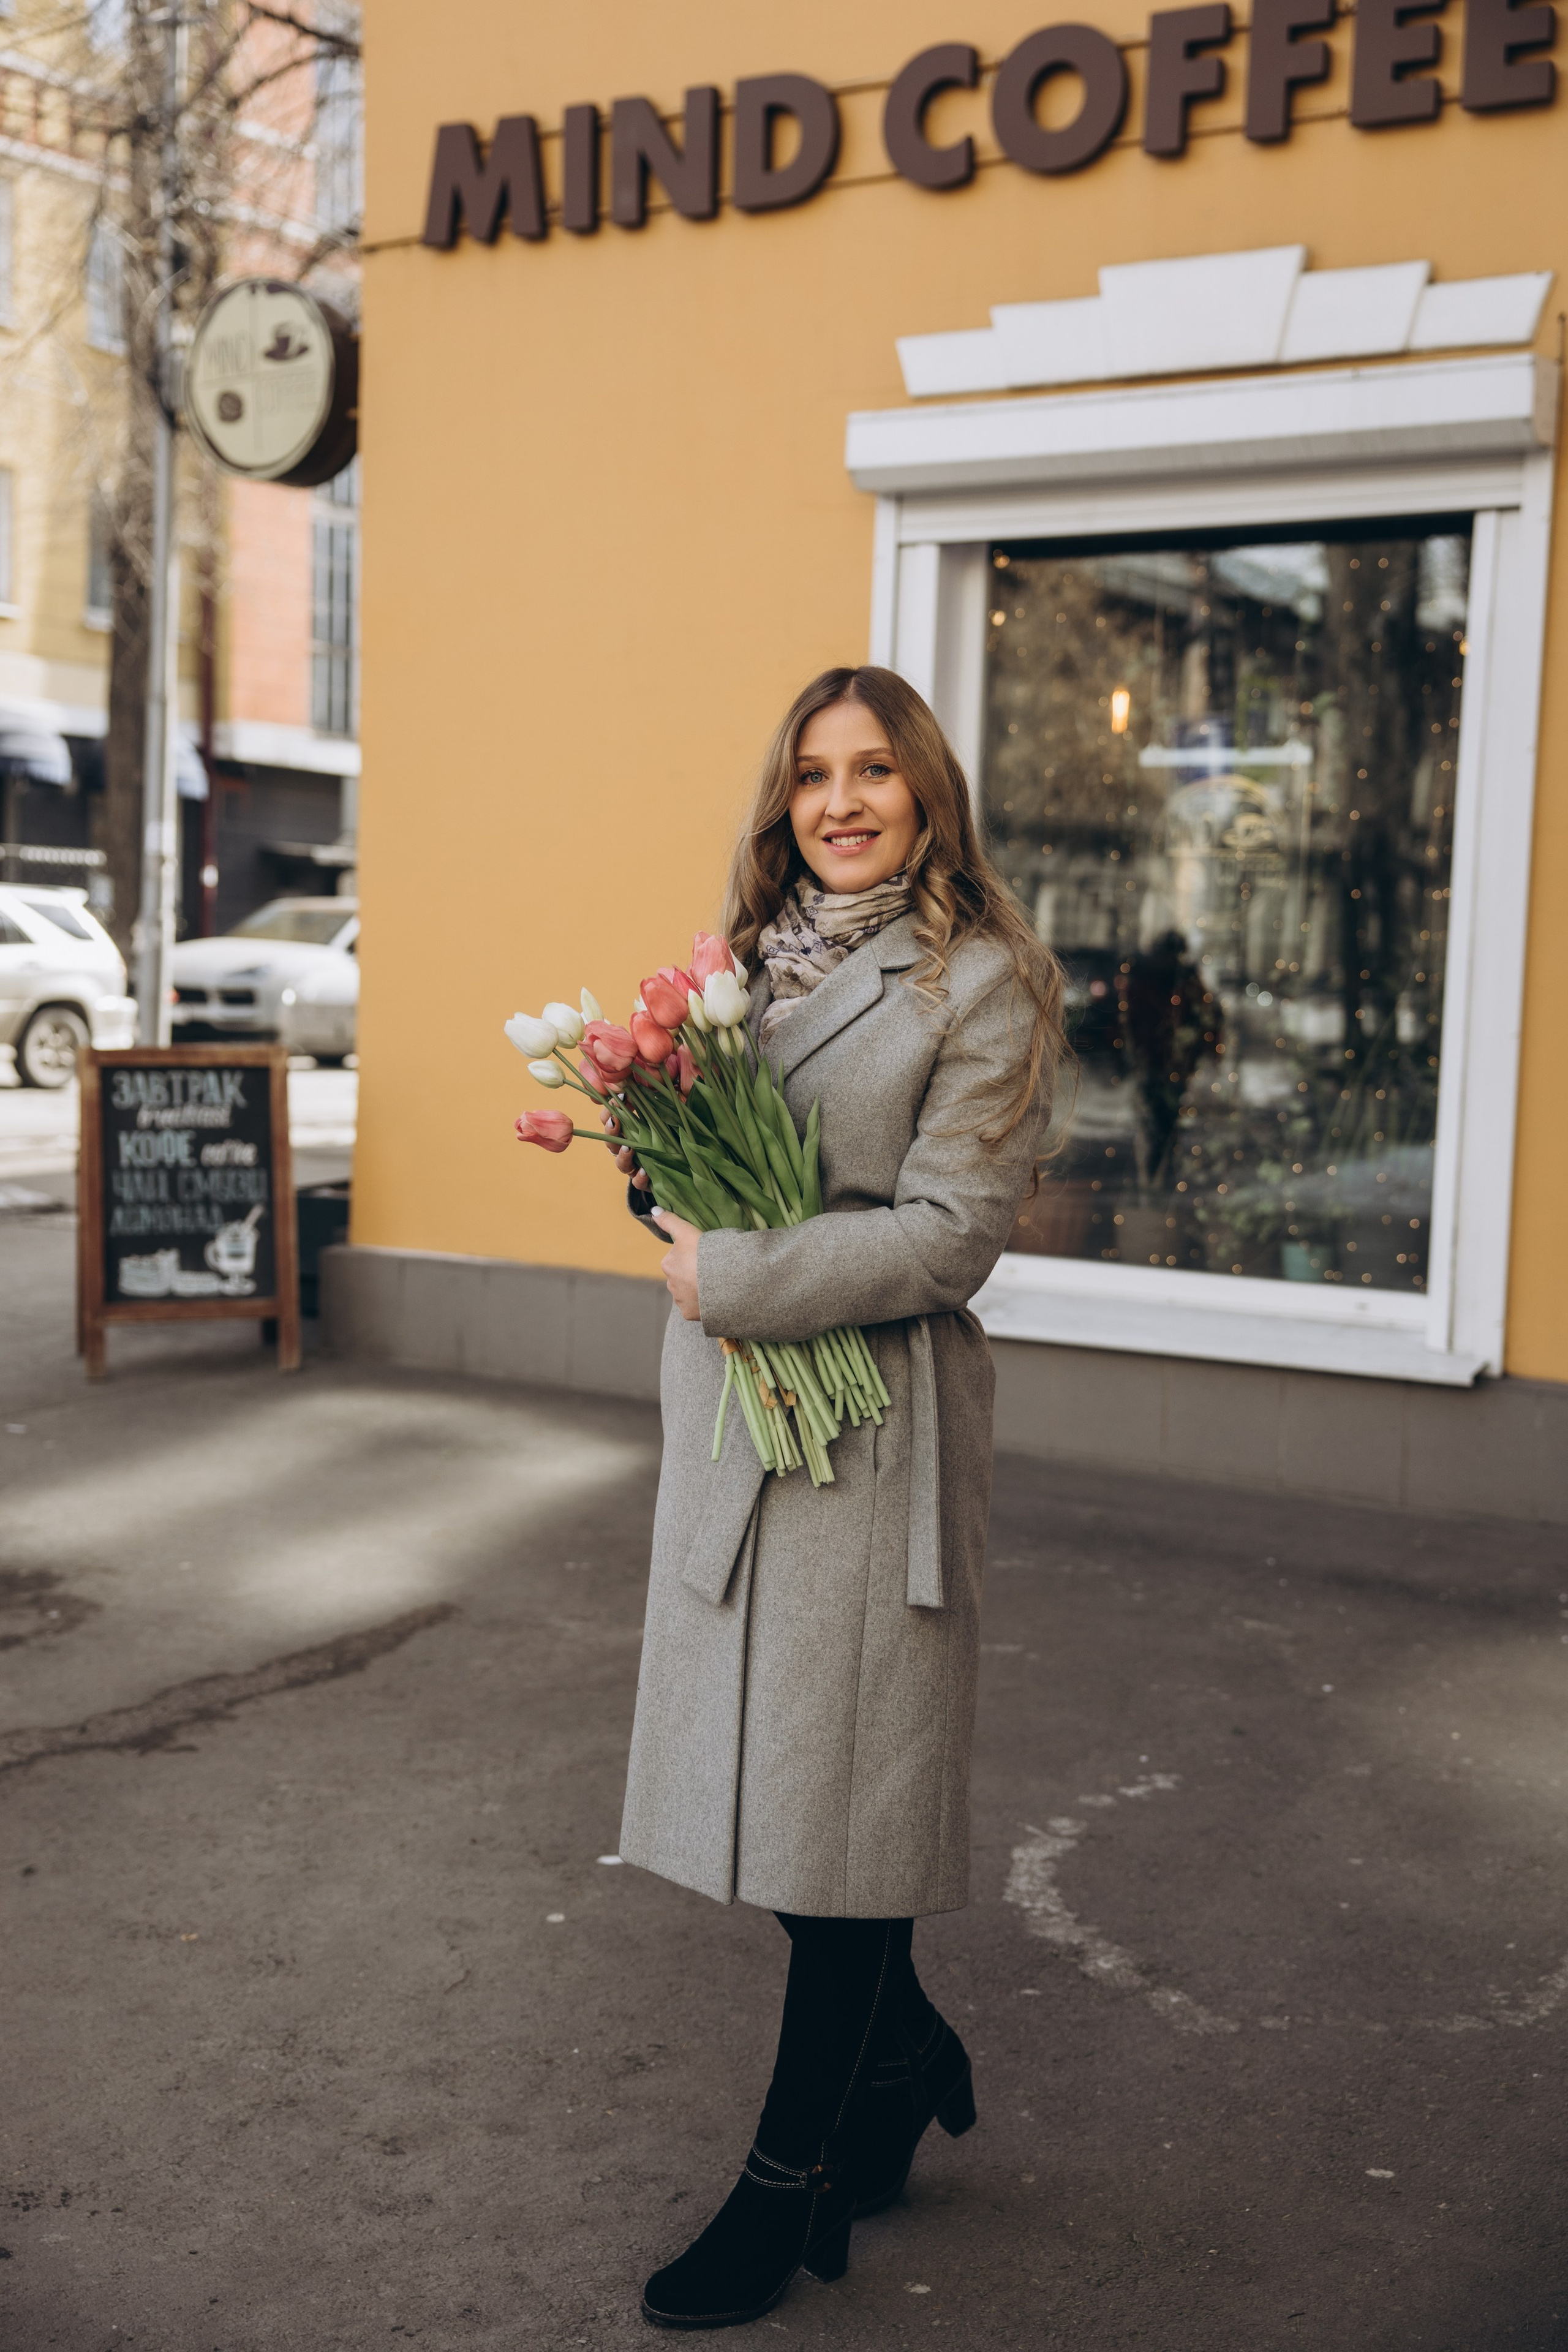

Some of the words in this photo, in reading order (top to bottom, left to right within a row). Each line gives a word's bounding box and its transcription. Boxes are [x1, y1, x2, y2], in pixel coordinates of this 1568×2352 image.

[423, 74, 840, 251] MIND
[883, 0, 1555, 192] COFFEE
[111, 1070, 247, 1109] ЗАВТРАК
[118, 1129, 197, 1167] КОФЕ
